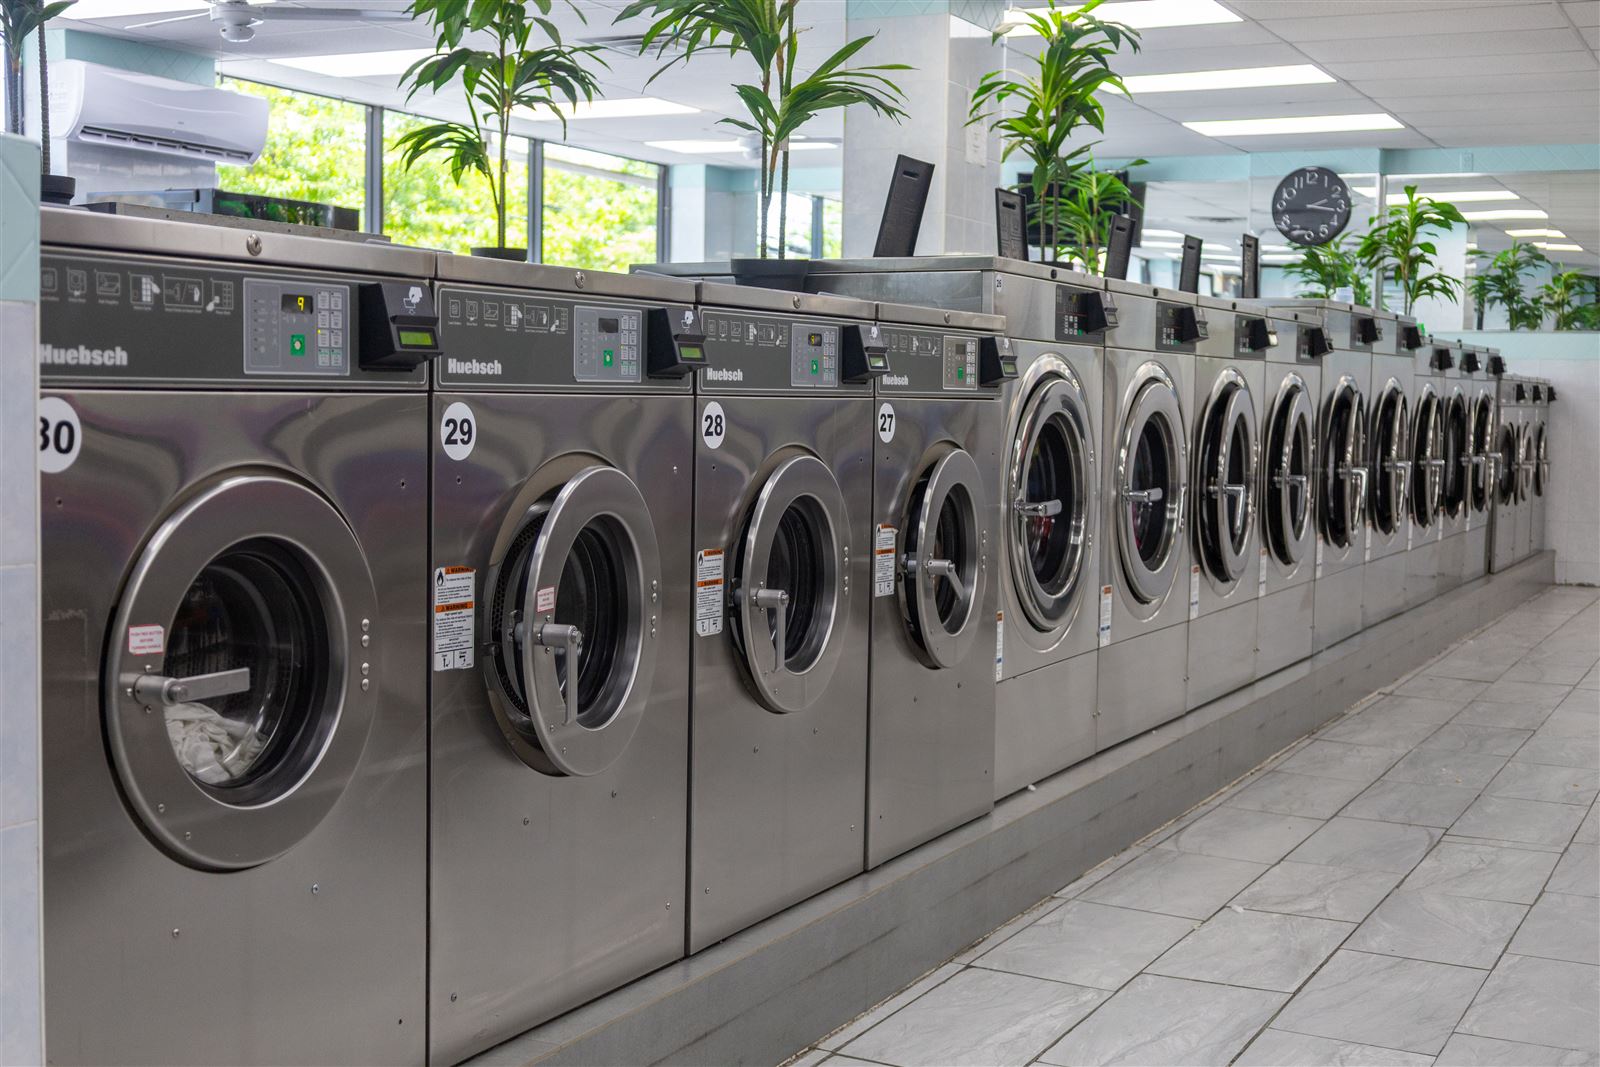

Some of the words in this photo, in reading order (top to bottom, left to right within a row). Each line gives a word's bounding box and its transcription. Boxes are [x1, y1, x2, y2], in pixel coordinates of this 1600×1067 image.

[1294, 176, 1304, 189] 11
[1306, 172, 1318, 184] 12
[1324, 175, 1328, 188] 1
[1282, 187, 1297, 200] 10
[1331, 185, 1342, 198] 2
[1336, 199, 1345, 213] 3
[1329, 214, 1338, 226] 4
[1319, 224, 1329, 237] 5
[297, 296, 305, 312] 9
[40, 344, 128, 366] Huebsch
[447, 357, 502, 375] Huebsch
[706, 367, 743, 381] Huebsch
[882, 374, 909, 386] Huebsch
[704, 414, 723, 436] 28
[879, 413, 894, 432] 27
[444, 417, 473, 445] 29
